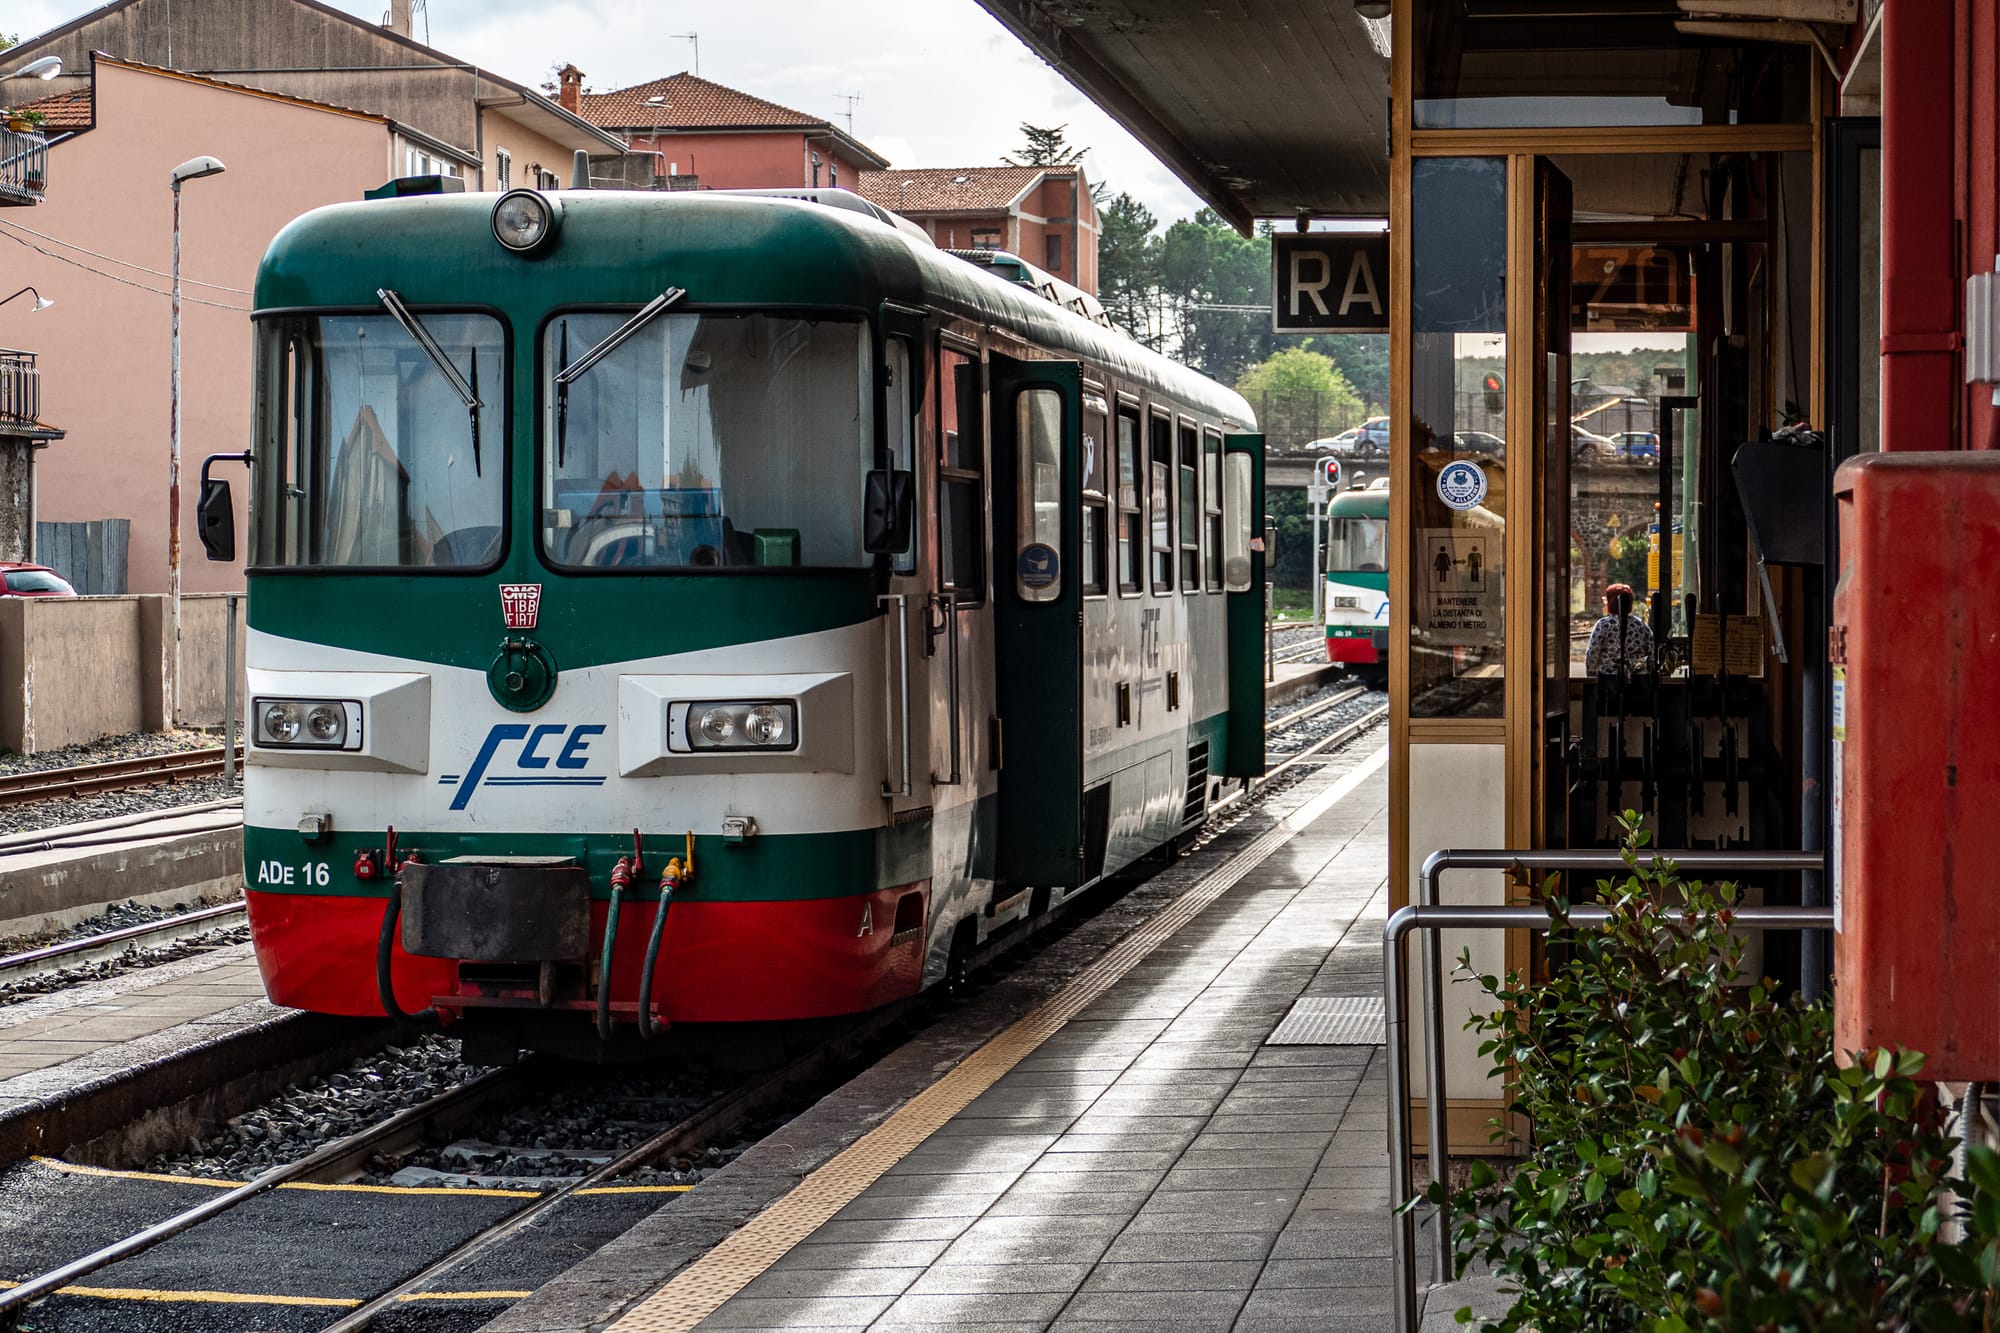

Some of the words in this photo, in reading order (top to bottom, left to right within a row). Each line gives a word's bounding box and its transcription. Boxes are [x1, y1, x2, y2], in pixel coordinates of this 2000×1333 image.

[1290, 250, 1383, 316] RA
[503, 586, 538, 599] OMS
[504, 600, 536, 613] TIBB
[1437, 597, 1478, 606] MANTENERE
[507, 612, 535, 626] FIAT
[1433, 609, 1441, 617] LA
[1443, 609, 1474, 617] DISTANZA
[1475, 609, 1482, 617] DI
[1429, 621, 1456, 629] ALMENO
[1463, 621, 1487, 629] METRO
[449, 724, 607, 810] FCE
[302, 862, 330, 886] 16
[857, 900, 873, 937] A
